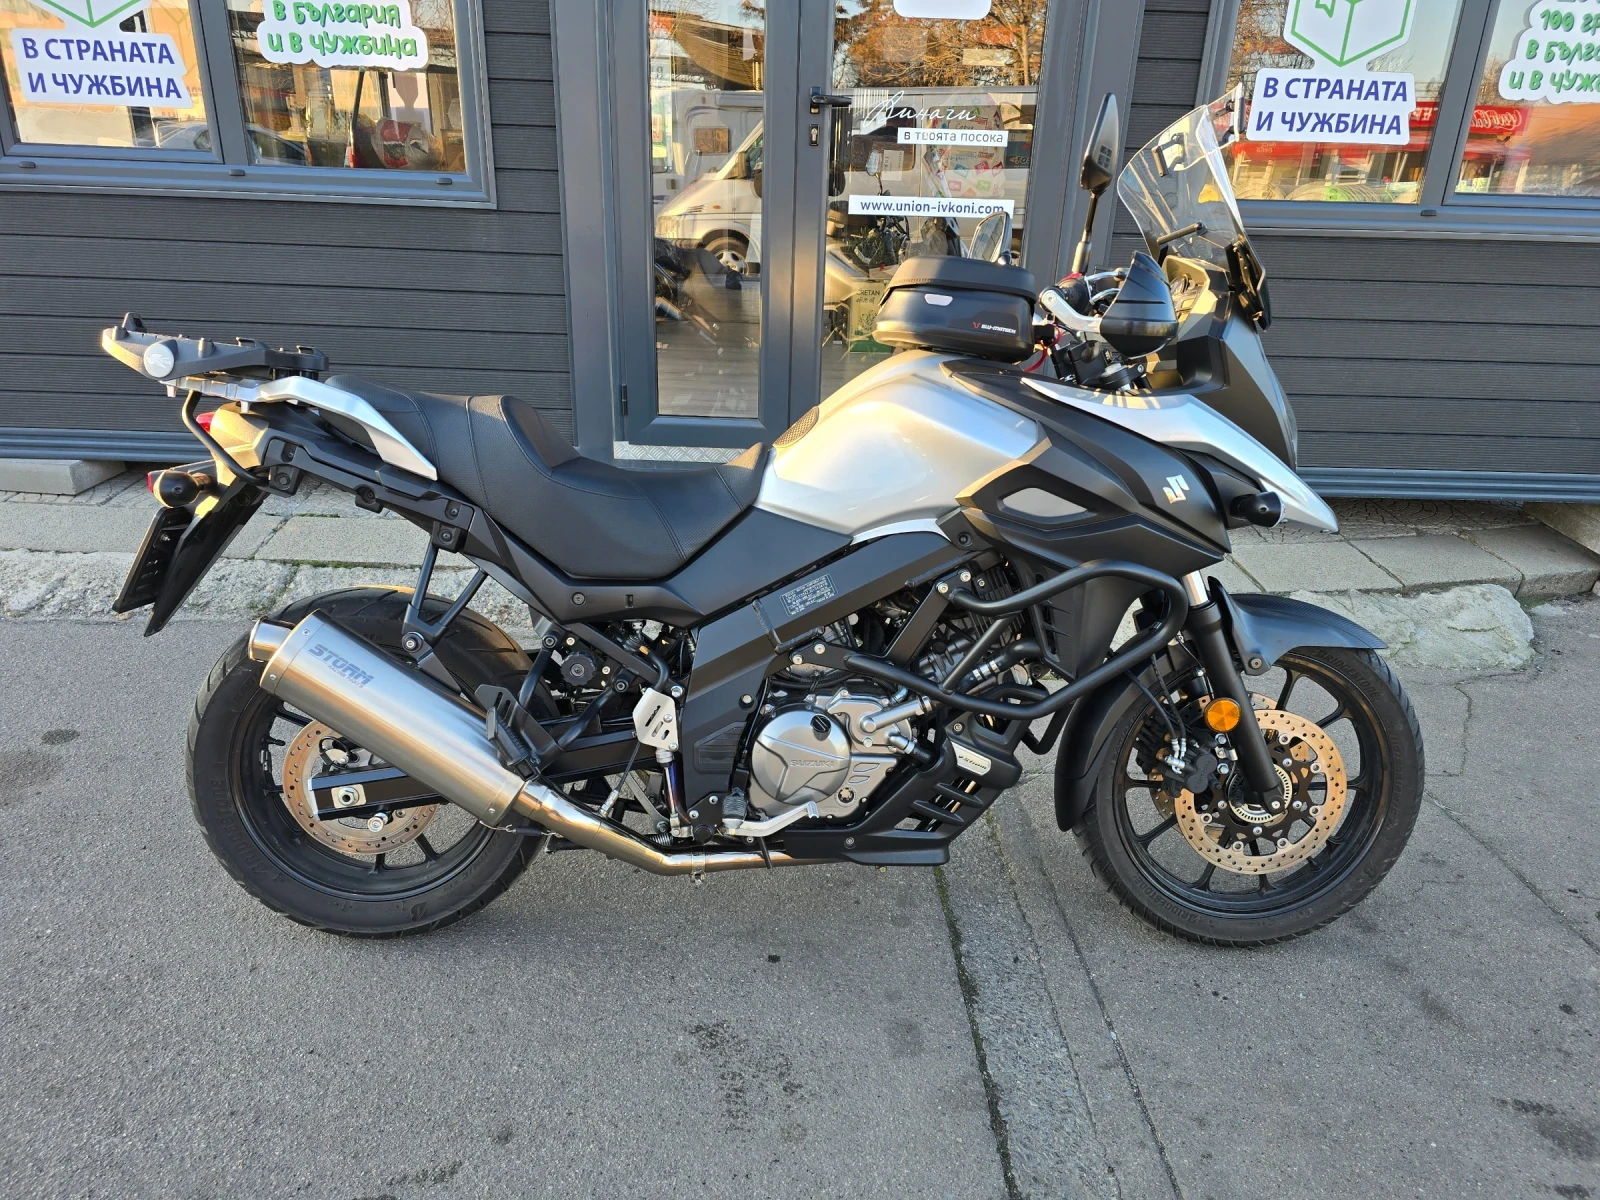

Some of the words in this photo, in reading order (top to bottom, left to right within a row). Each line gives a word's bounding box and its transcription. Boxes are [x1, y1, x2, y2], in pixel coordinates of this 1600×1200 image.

[293, 2, 401, 28] България
[1540, 9, 1575, 32] 100
[22, 37, 39, 59] В
[44, 38, 175, 64] СТРАНАТА
[267, 33, 283, 52] и
[309, 31, 417, 59] чужбина
[28, 72, 47, 93] И
[51, 73, 182, 99] ЧУЖБИНА
[1263, 77, 1279, 98] В
[1284, 77, 1408, 102] СТРАНАТА
[863, 90, 977, 128] Винаги
[1255, 111, 1274, 131] И
[1280, 112, 1402, 136] ЧУЖБИНА
[915, 131, 957, 143] твоята
[960, 133, 1004, 143] посока
[860, 200, 1004, 215] www.union-ivkoni.com
[308, 644, 375, 685] STORM
[790, 760, 834, 768] SUZUKI
